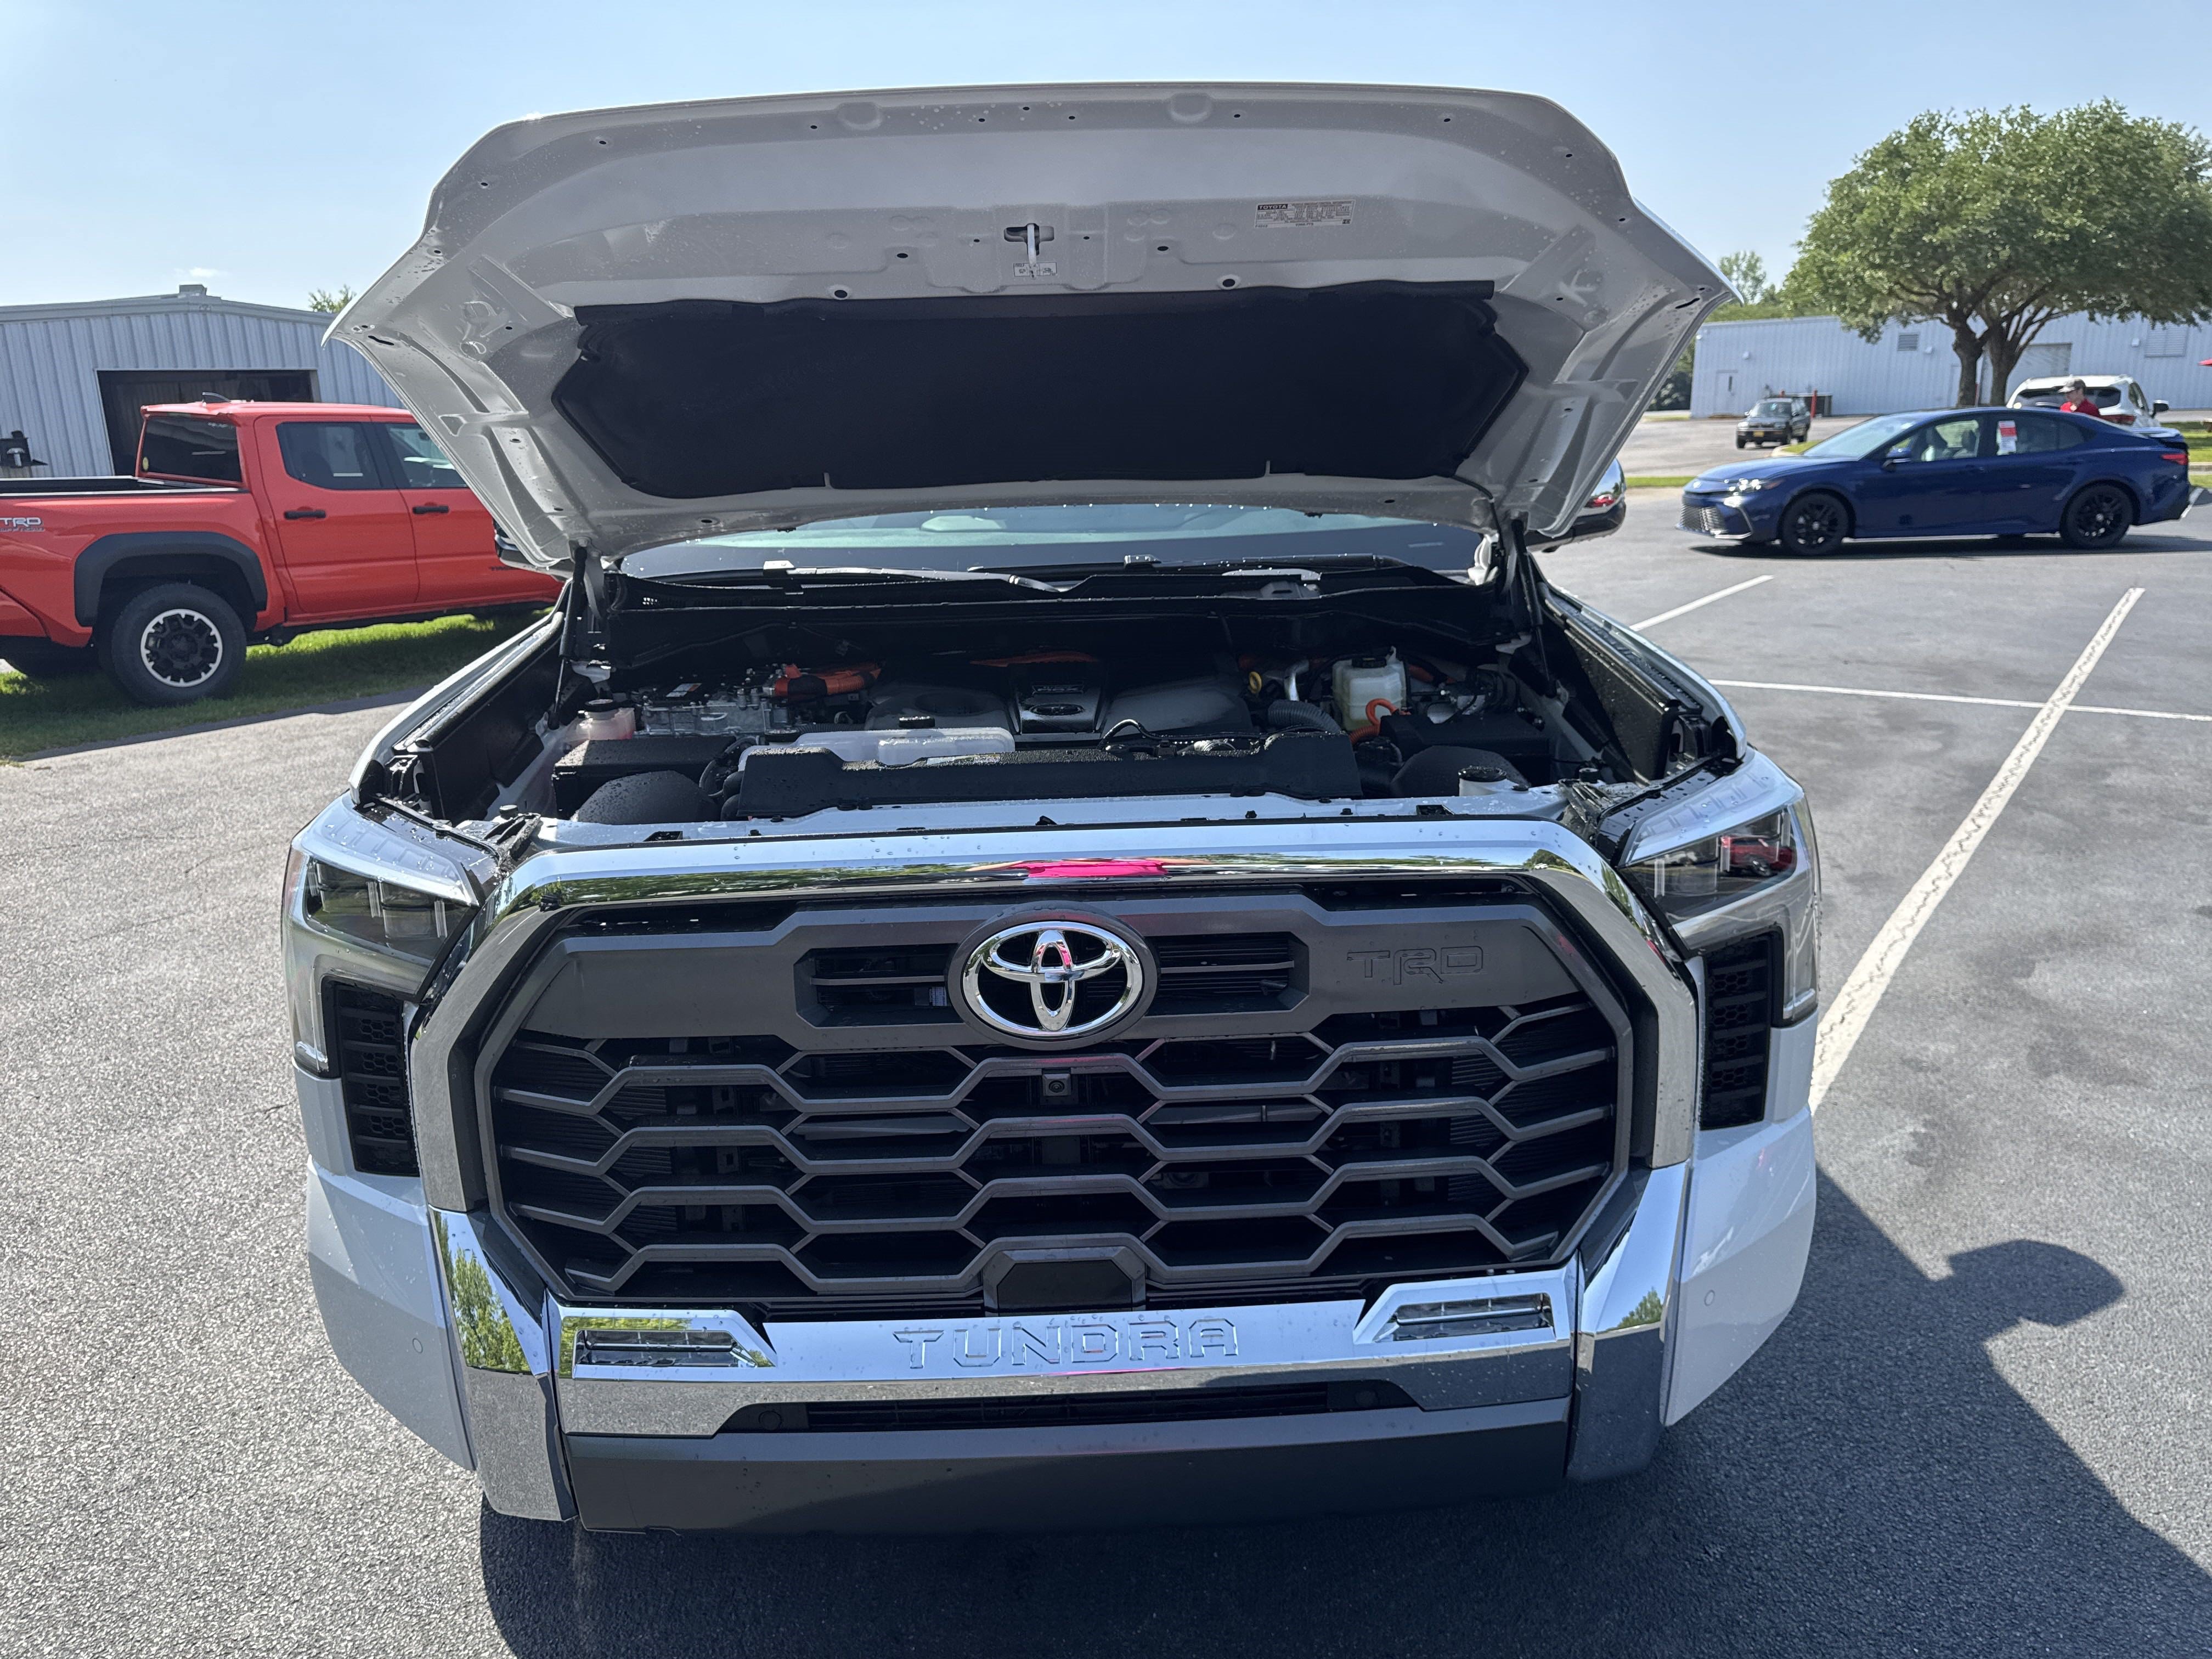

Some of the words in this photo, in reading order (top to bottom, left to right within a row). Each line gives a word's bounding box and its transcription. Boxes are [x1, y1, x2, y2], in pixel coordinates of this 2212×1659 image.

[0, 517, 41, 527] TRD
[1346, 946, 1483, 985] TRD
[893, 1318, 1238, 1369] TUNDRA
